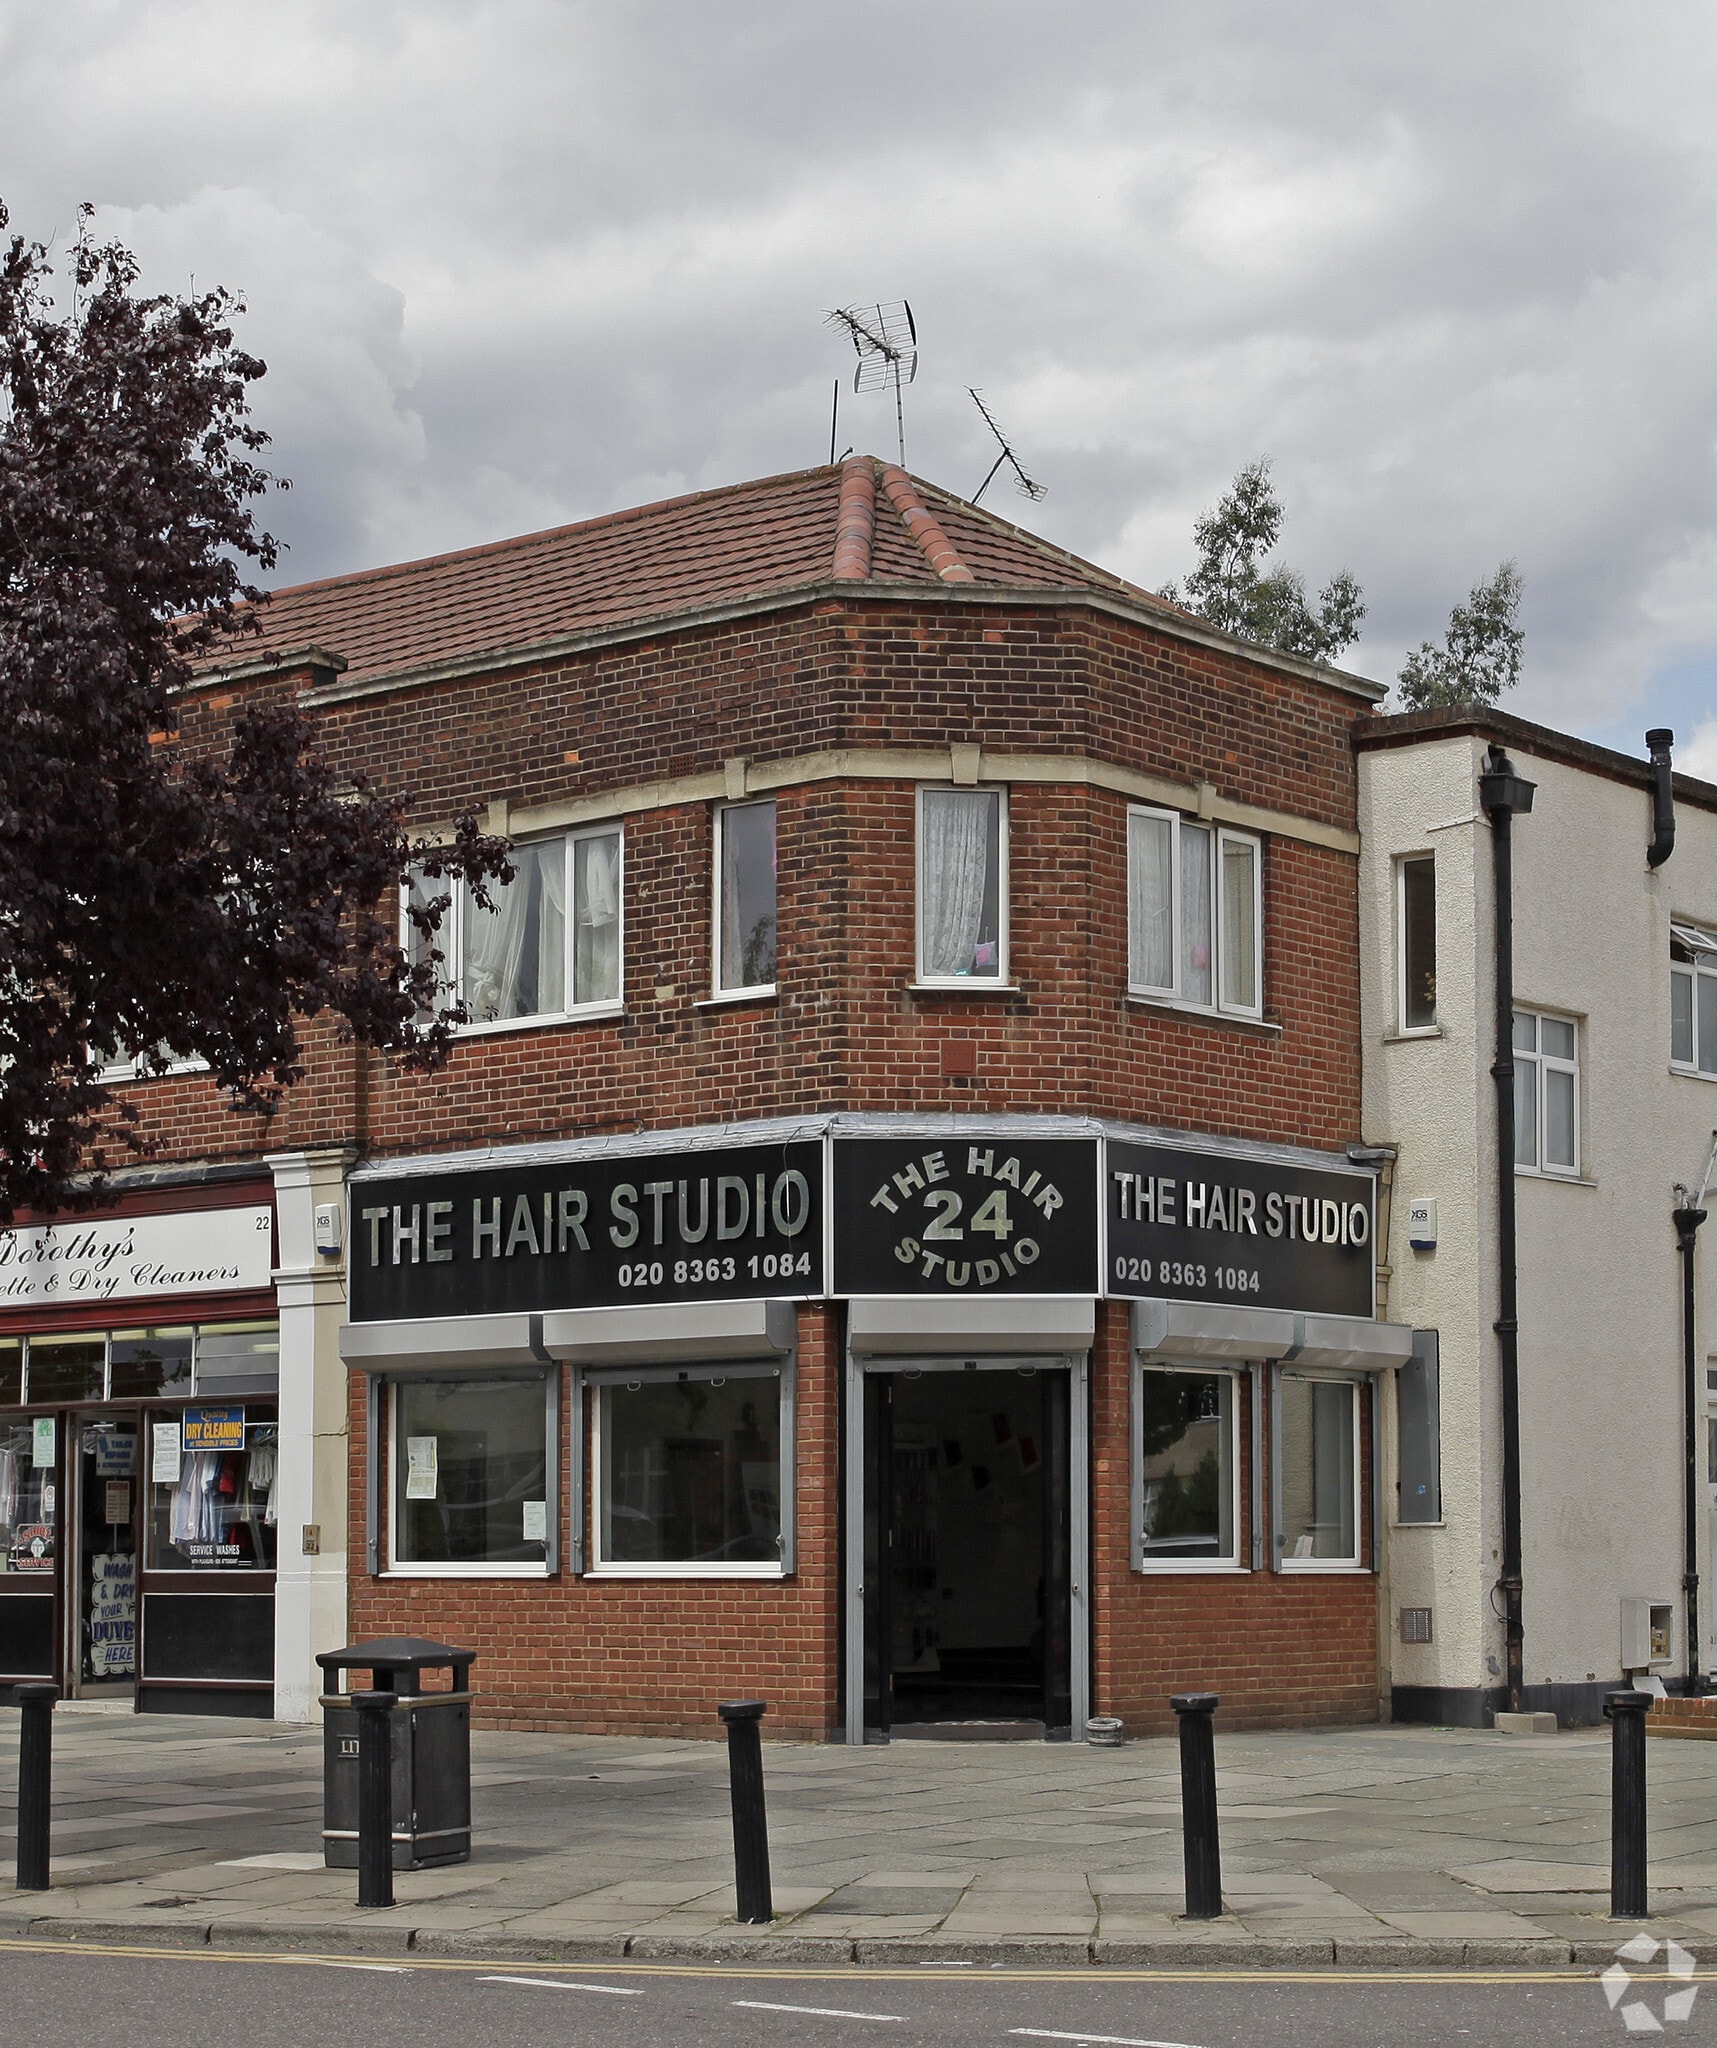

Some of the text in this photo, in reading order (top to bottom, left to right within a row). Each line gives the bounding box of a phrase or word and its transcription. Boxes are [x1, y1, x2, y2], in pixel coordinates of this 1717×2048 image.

[872, 1146, 1064, 1221] THE HAIR
[255, 1216, 270, 1231] 22
[362, 1169, 810, 1266] THE HAIR STUDIO
[922, 1189, 1014, 1241] 24
[1114, 1171, 1369, 1247] THE HAIR STUDIO
[0, 1226, 136, 1272] Dorothy's
[894, 1236, 1041, 1287] STUDIO
[44, 1273, 60, 1293] &
[69, 1267, 120, 1299] Dry
[130, 1262, 240, 1287] Cleaners
[618, 1252, 812, 1287] 020 8363 1084
[1115, 1256, 1260, 1293] 020 8363 1084
[186, 1423, 202, 1439] DRY
[204, 1422, 242, 1439] CLEANING
[189, 1544, 240, 1556] SERVICE WASHES
[103, 1563, 134, 1580] WASH
[105, 1647, 134, 1662] HERE
